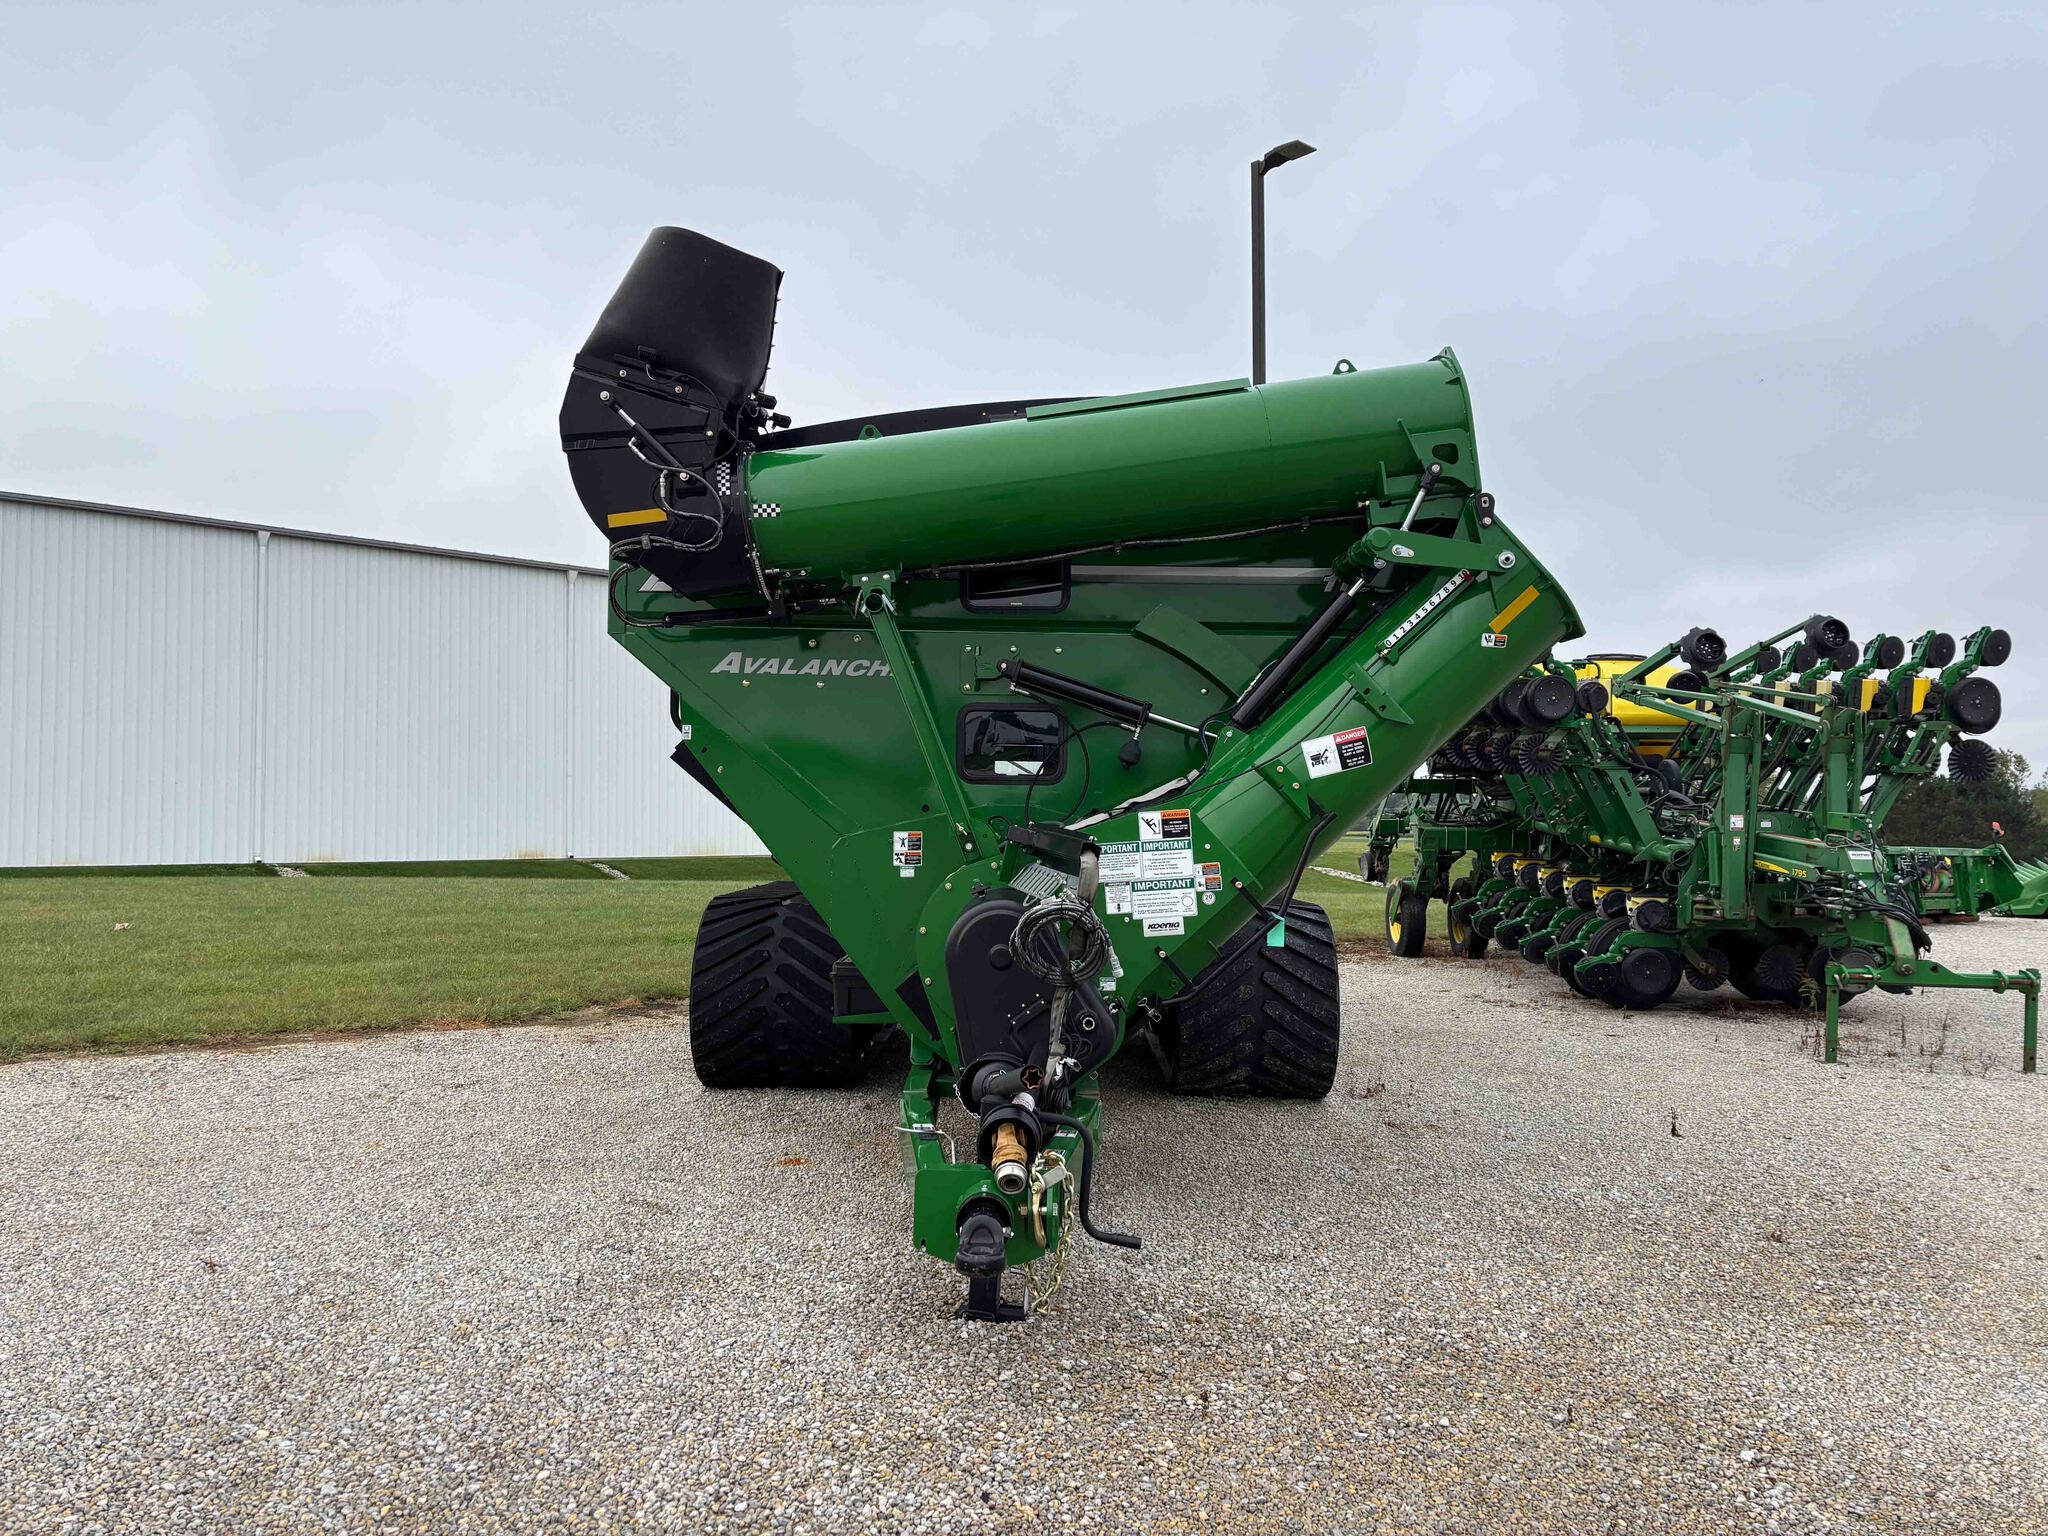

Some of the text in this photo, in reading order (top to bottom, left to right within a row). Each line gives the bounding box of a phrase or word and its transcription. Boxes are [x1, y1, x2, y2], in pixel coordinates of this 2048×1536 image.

[1385, 639, 1392, 647] 0
[1406, 619, 1414, 627] 3
[1421, 606, 1429, 614] 5
[1443, 586, 1450, 594] 8
[710, 651, 894, 677] AVALANCH
[1341, 730, 1366, 740] DANGER
[1100, 843, 1137, 853] PORTANT
[1143, 840, 1189, 852] IMPORTANT
[1792, 868, 1807, 878] 1795
[1134, 879, 1192, 891] IMPORTANT
